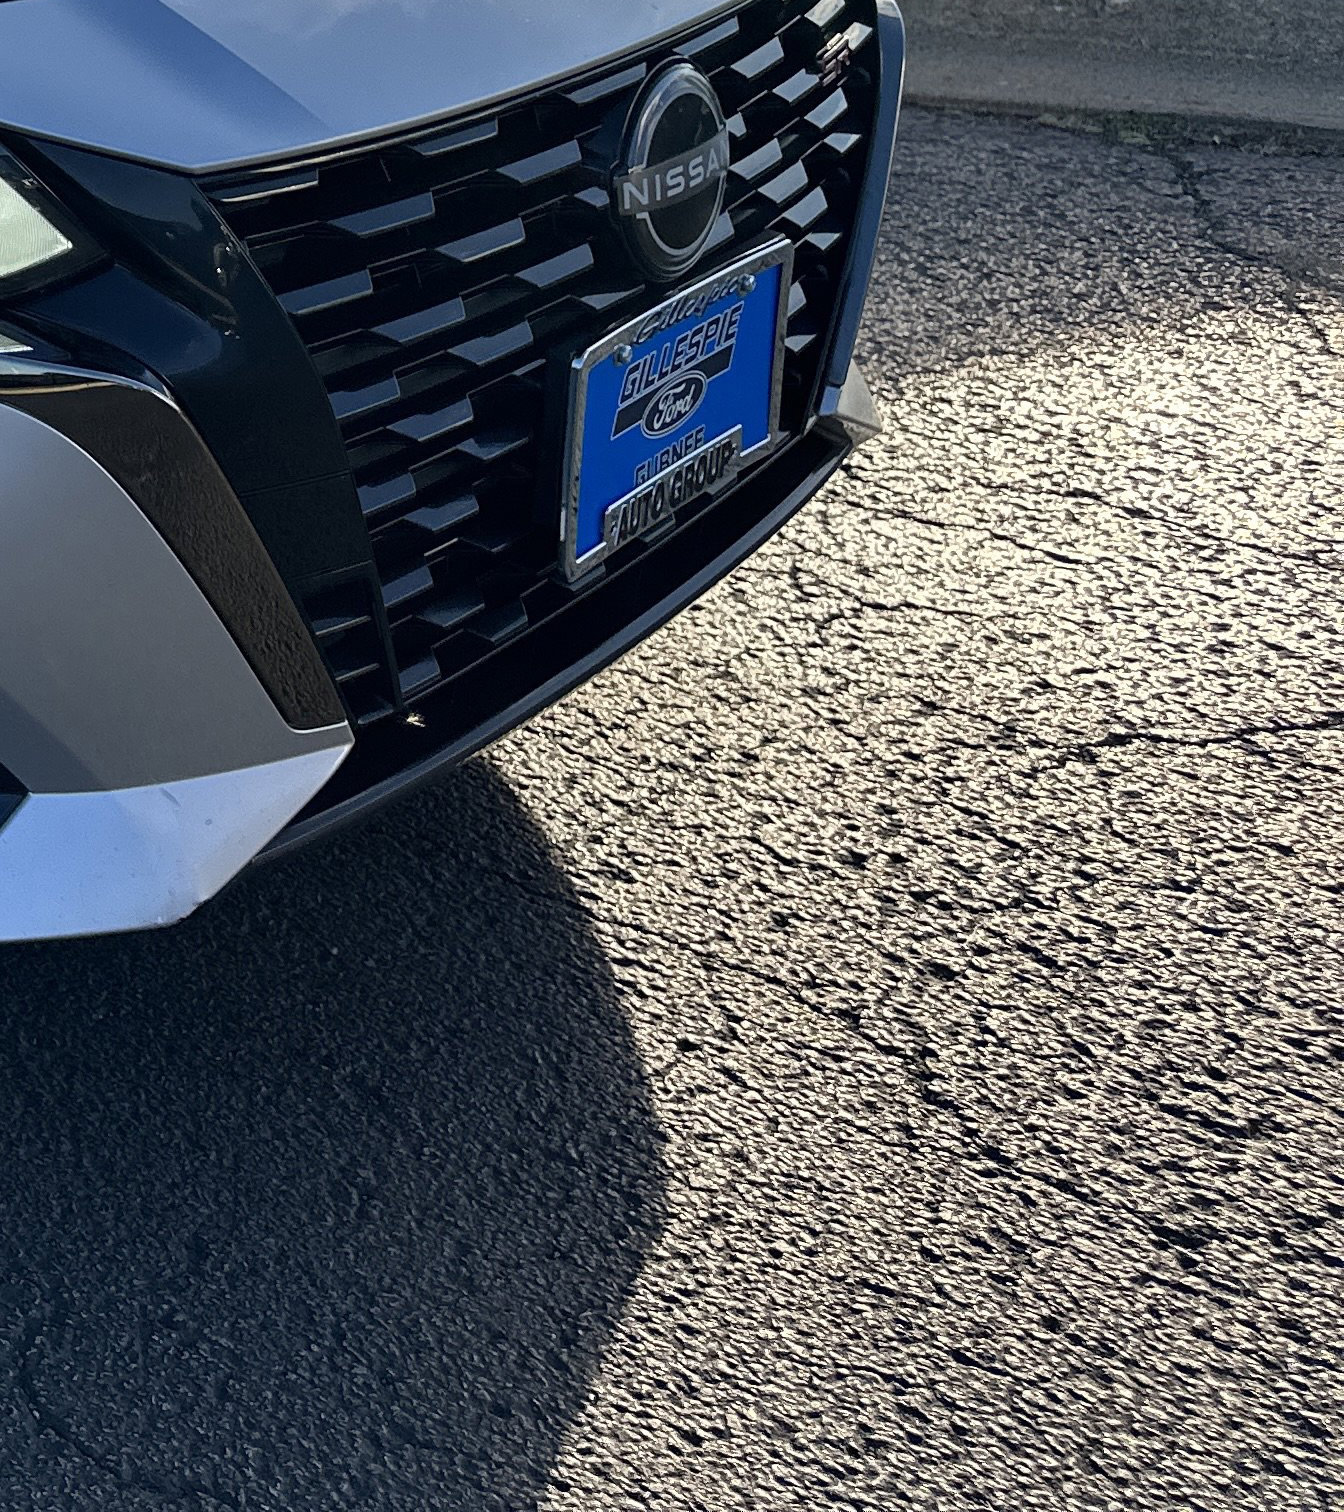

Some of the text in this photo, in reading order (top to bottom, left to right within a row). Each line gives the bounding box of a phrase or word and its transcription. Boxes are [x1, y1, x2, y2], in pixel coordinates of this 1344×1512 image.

[618, 300, 745, 407] GILLESPIE
[653, 382, 696, 430] Ford
[613, 438, 735, 547] AUTO GROUP
